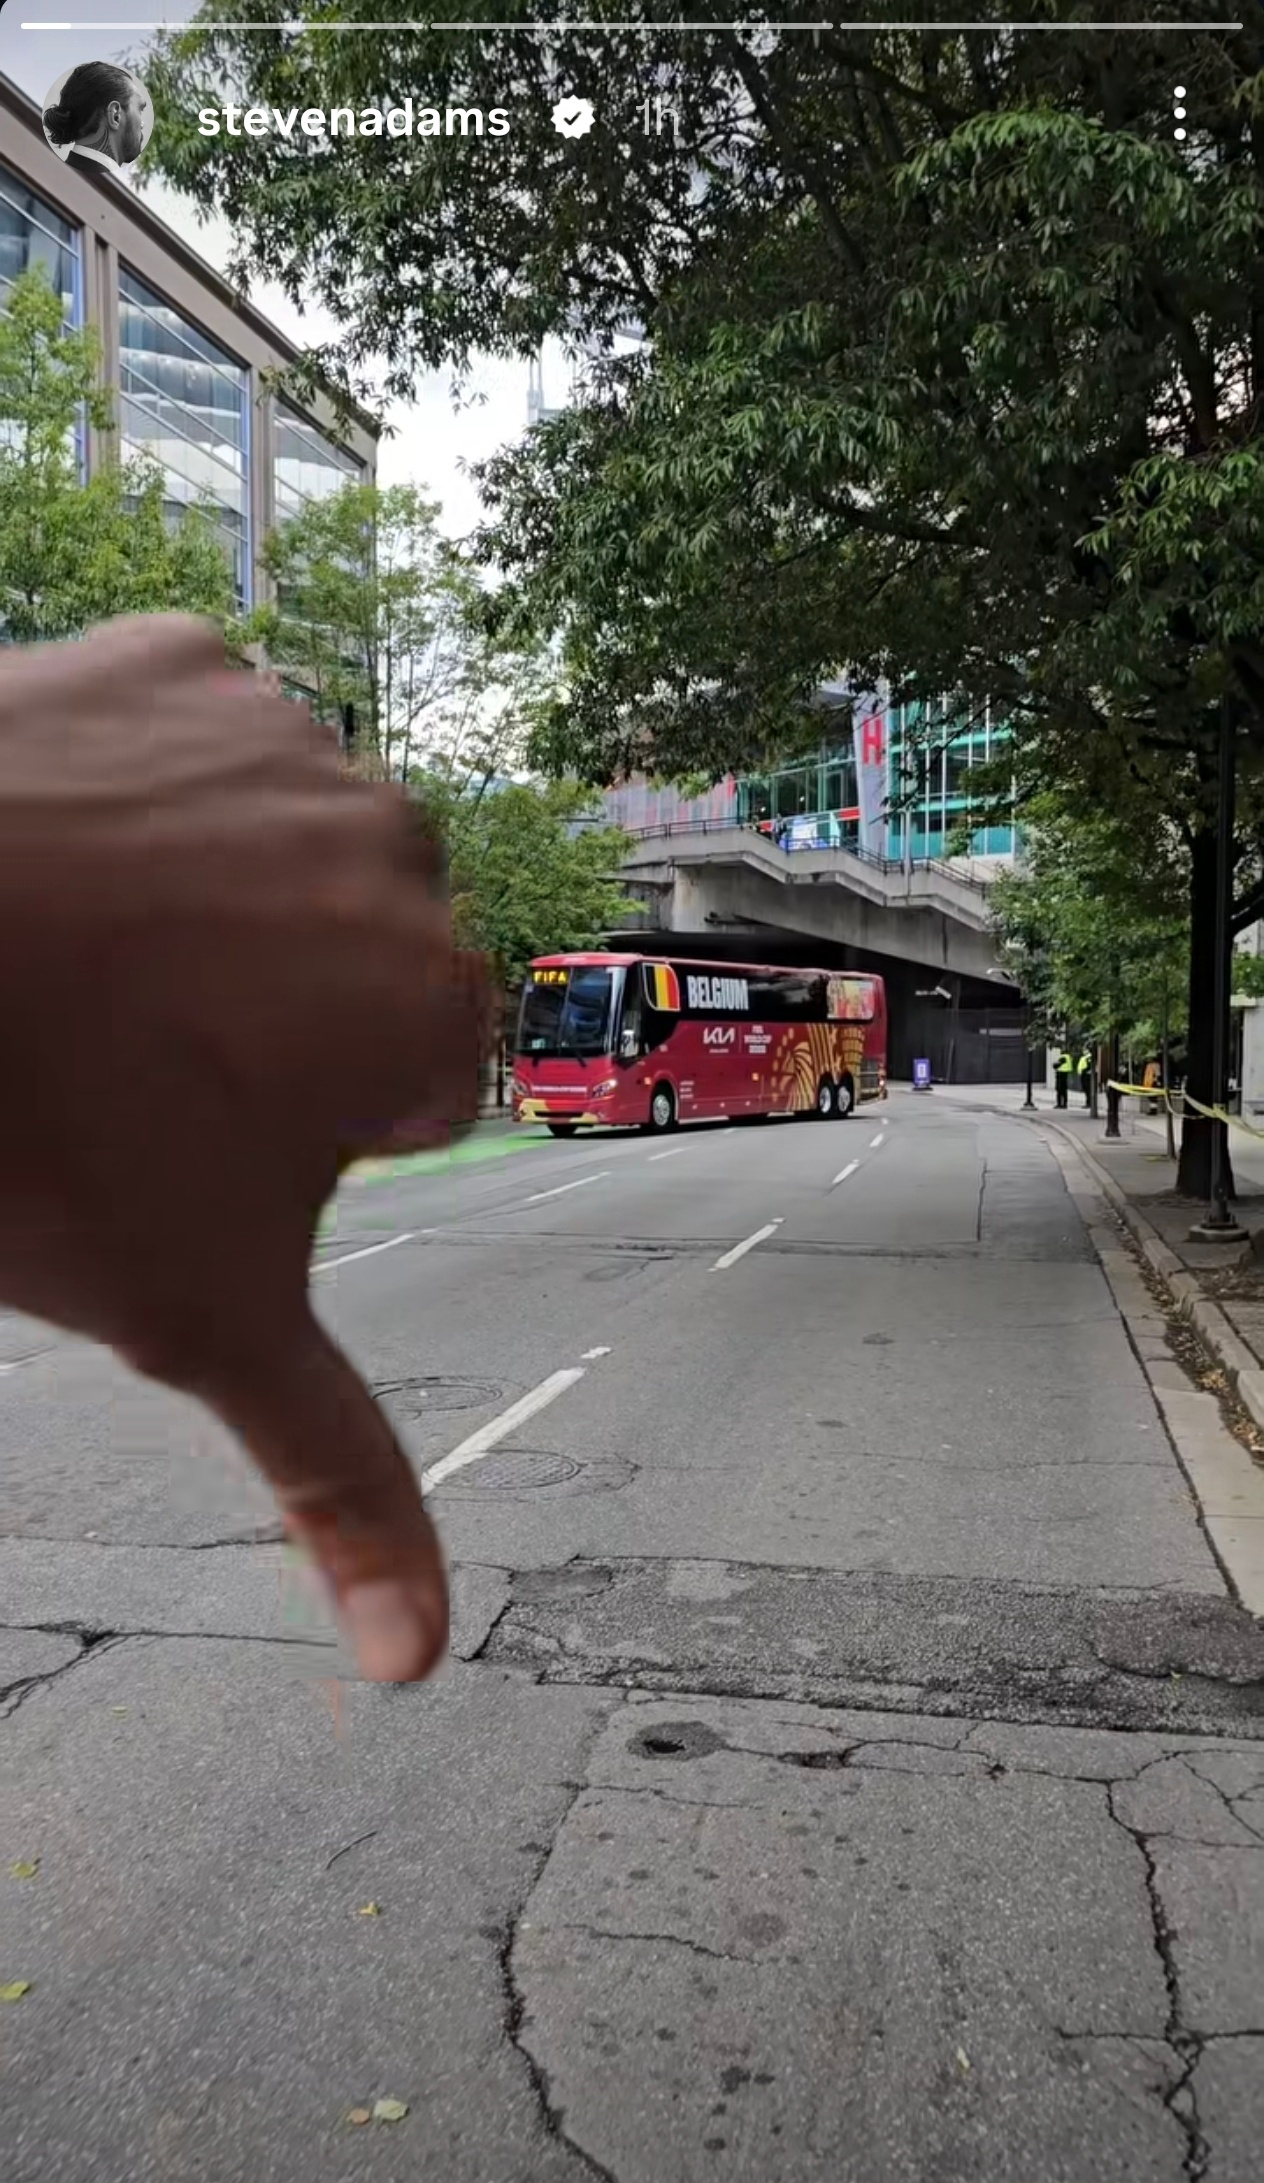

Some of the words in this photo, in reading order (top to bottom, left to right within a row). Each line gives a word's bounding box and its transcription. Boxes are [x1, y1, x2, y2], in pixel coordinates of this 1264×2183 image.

[863, 714, 883, 767] H
[534, 970, 567, 983] FIFA
[686, 974, 749, 1010] BELGIUM
[703, 1027, 735, 1044] KIA
